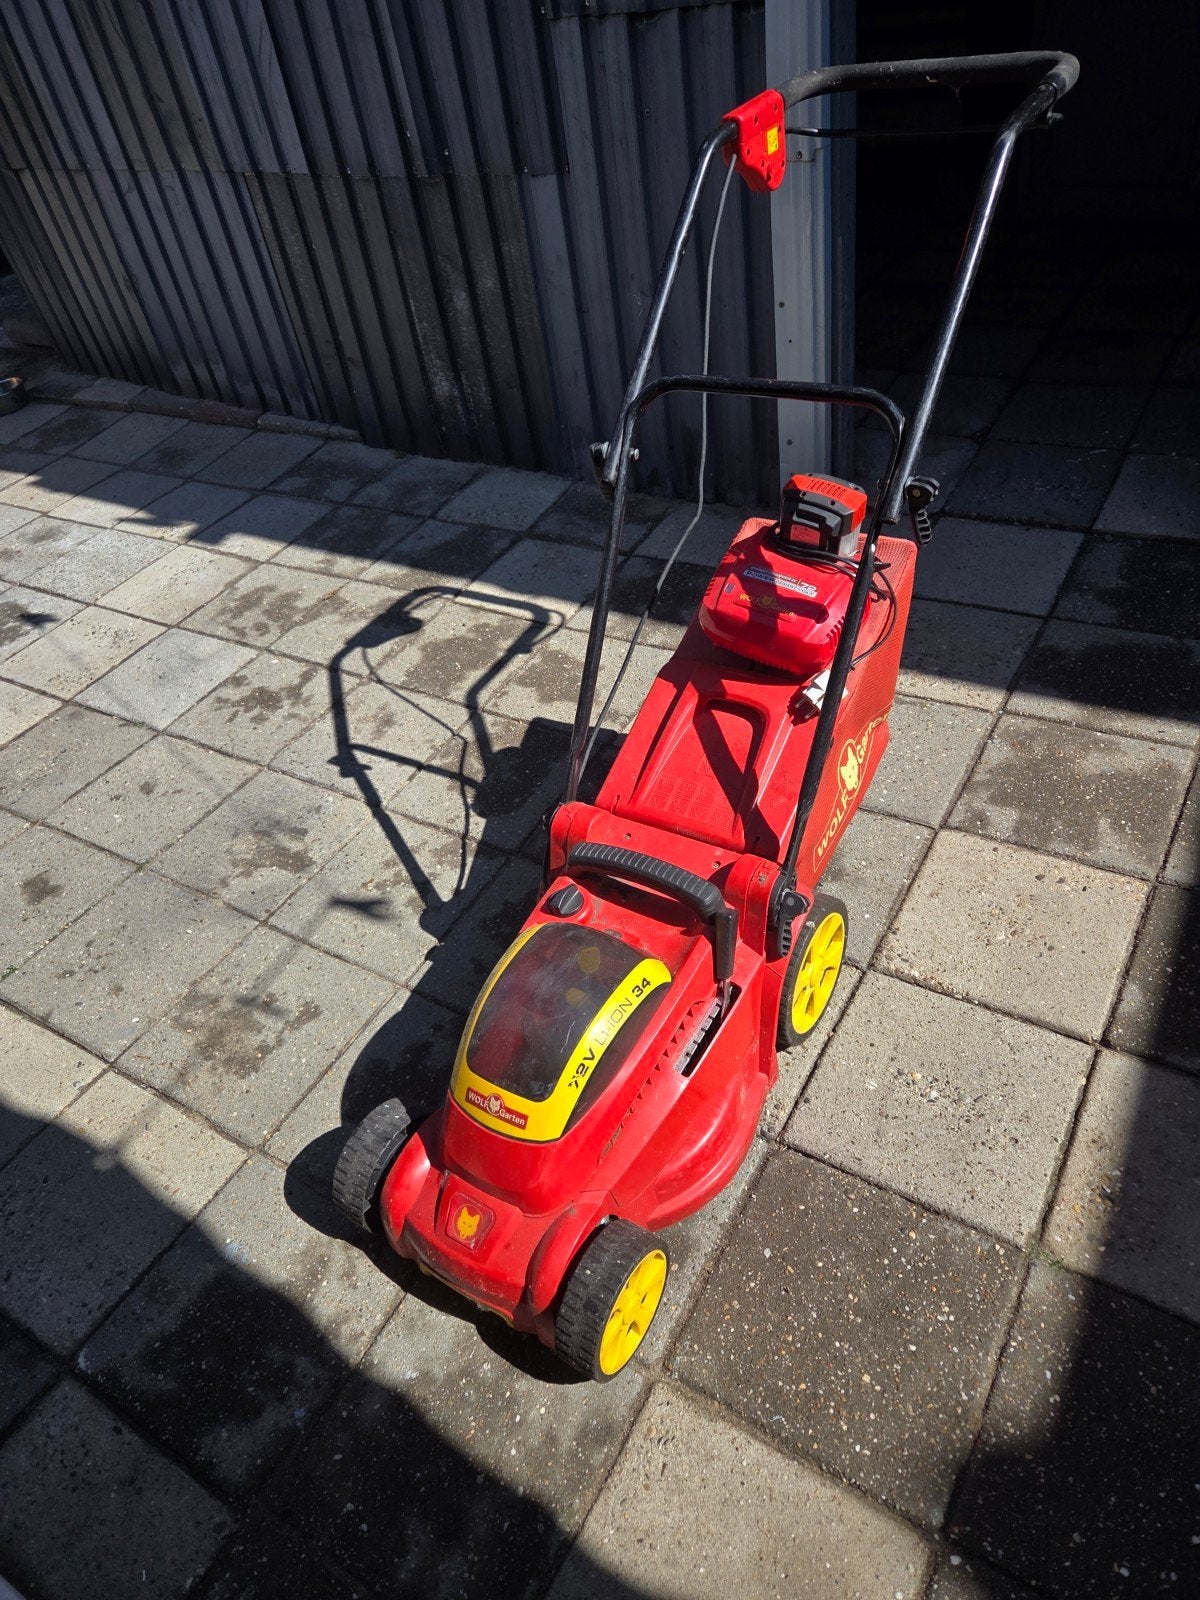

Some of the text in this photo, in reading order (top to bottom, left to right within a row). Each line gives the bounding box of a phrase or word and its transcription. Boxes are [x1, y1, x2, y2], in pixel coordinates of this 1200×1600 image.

[817, 788, 849, 857] WOLF
[631, 977, 652, 998] 34
[468, 1090, 526, 1126] WOLF Garten
